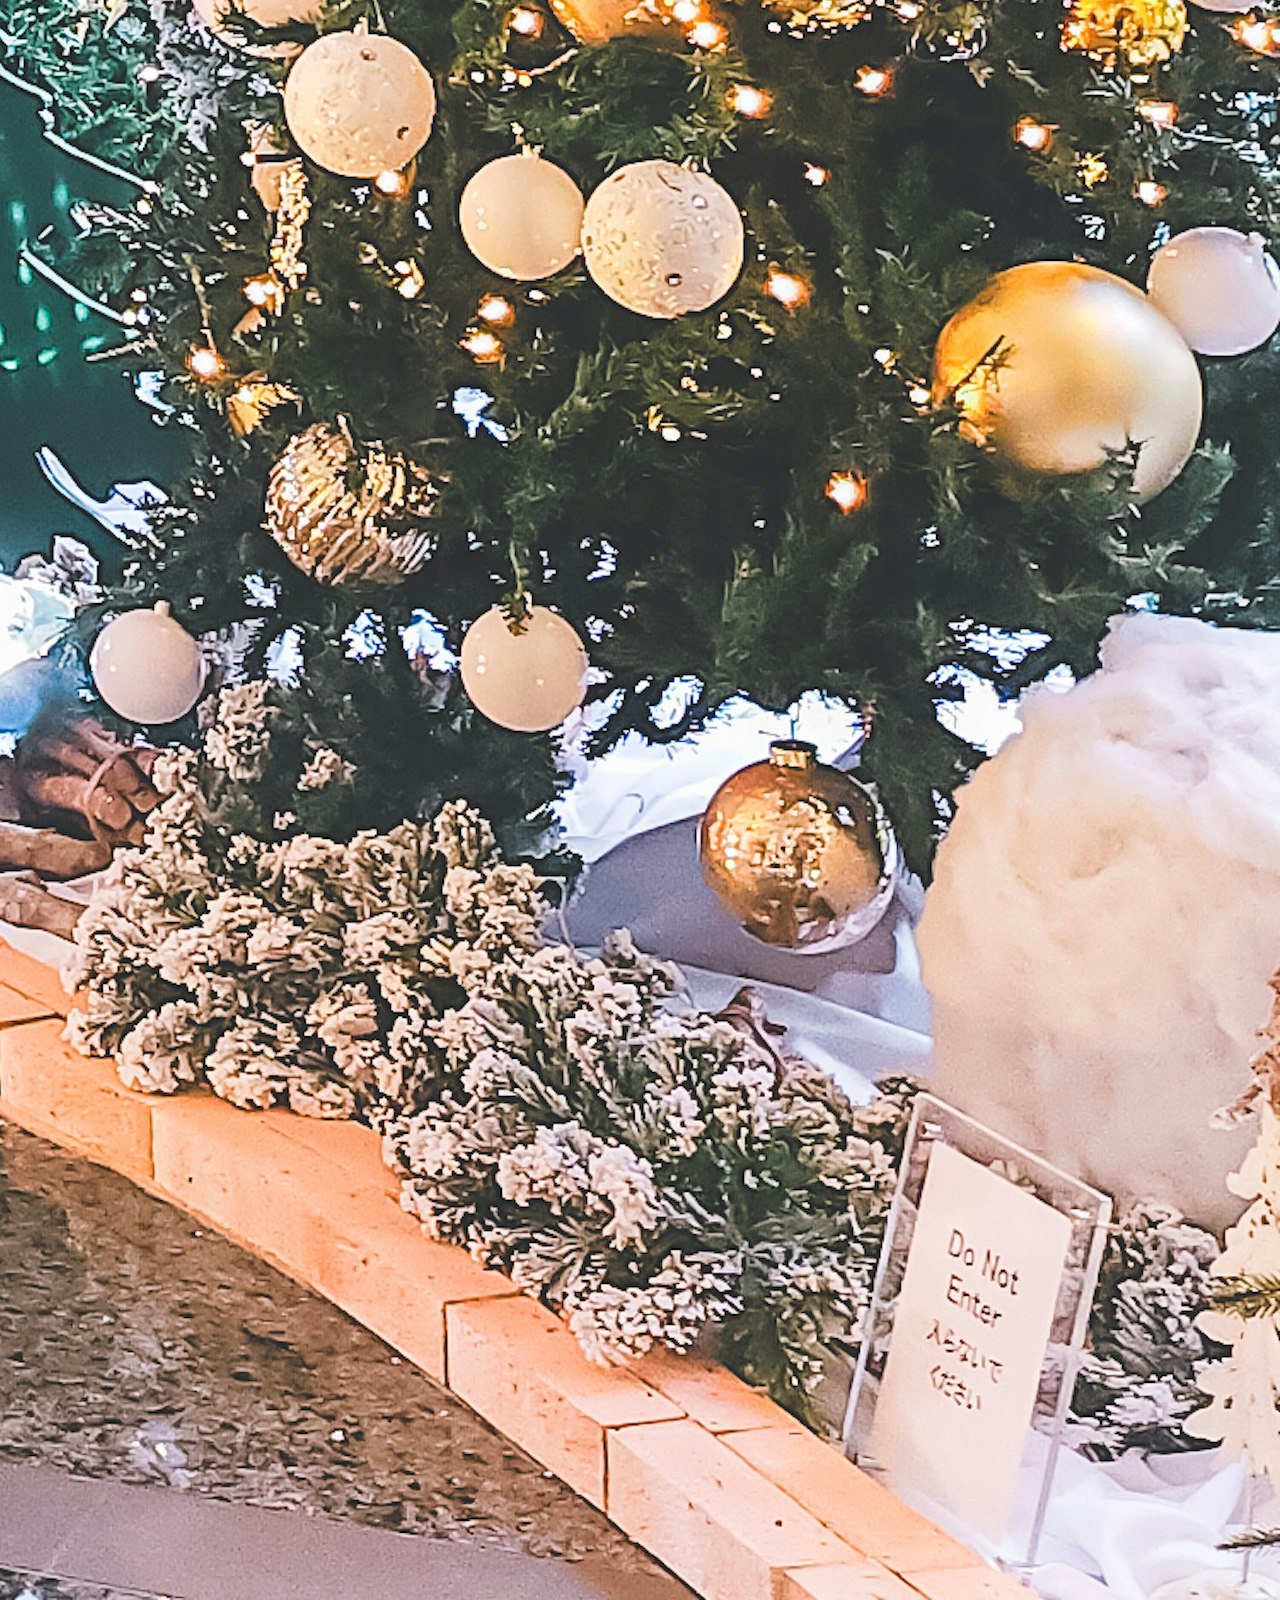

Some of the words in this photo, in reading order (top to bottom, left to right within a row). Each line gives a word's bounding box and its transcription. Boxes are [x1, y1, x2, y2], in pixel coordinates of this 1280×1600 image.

[948, 1228, 974, 1266] Do
[981, 1249, 1018, 1295] Not
[946, 1273, 1002, 1328] Enter
[930, 1364, 982, 1410] ください
